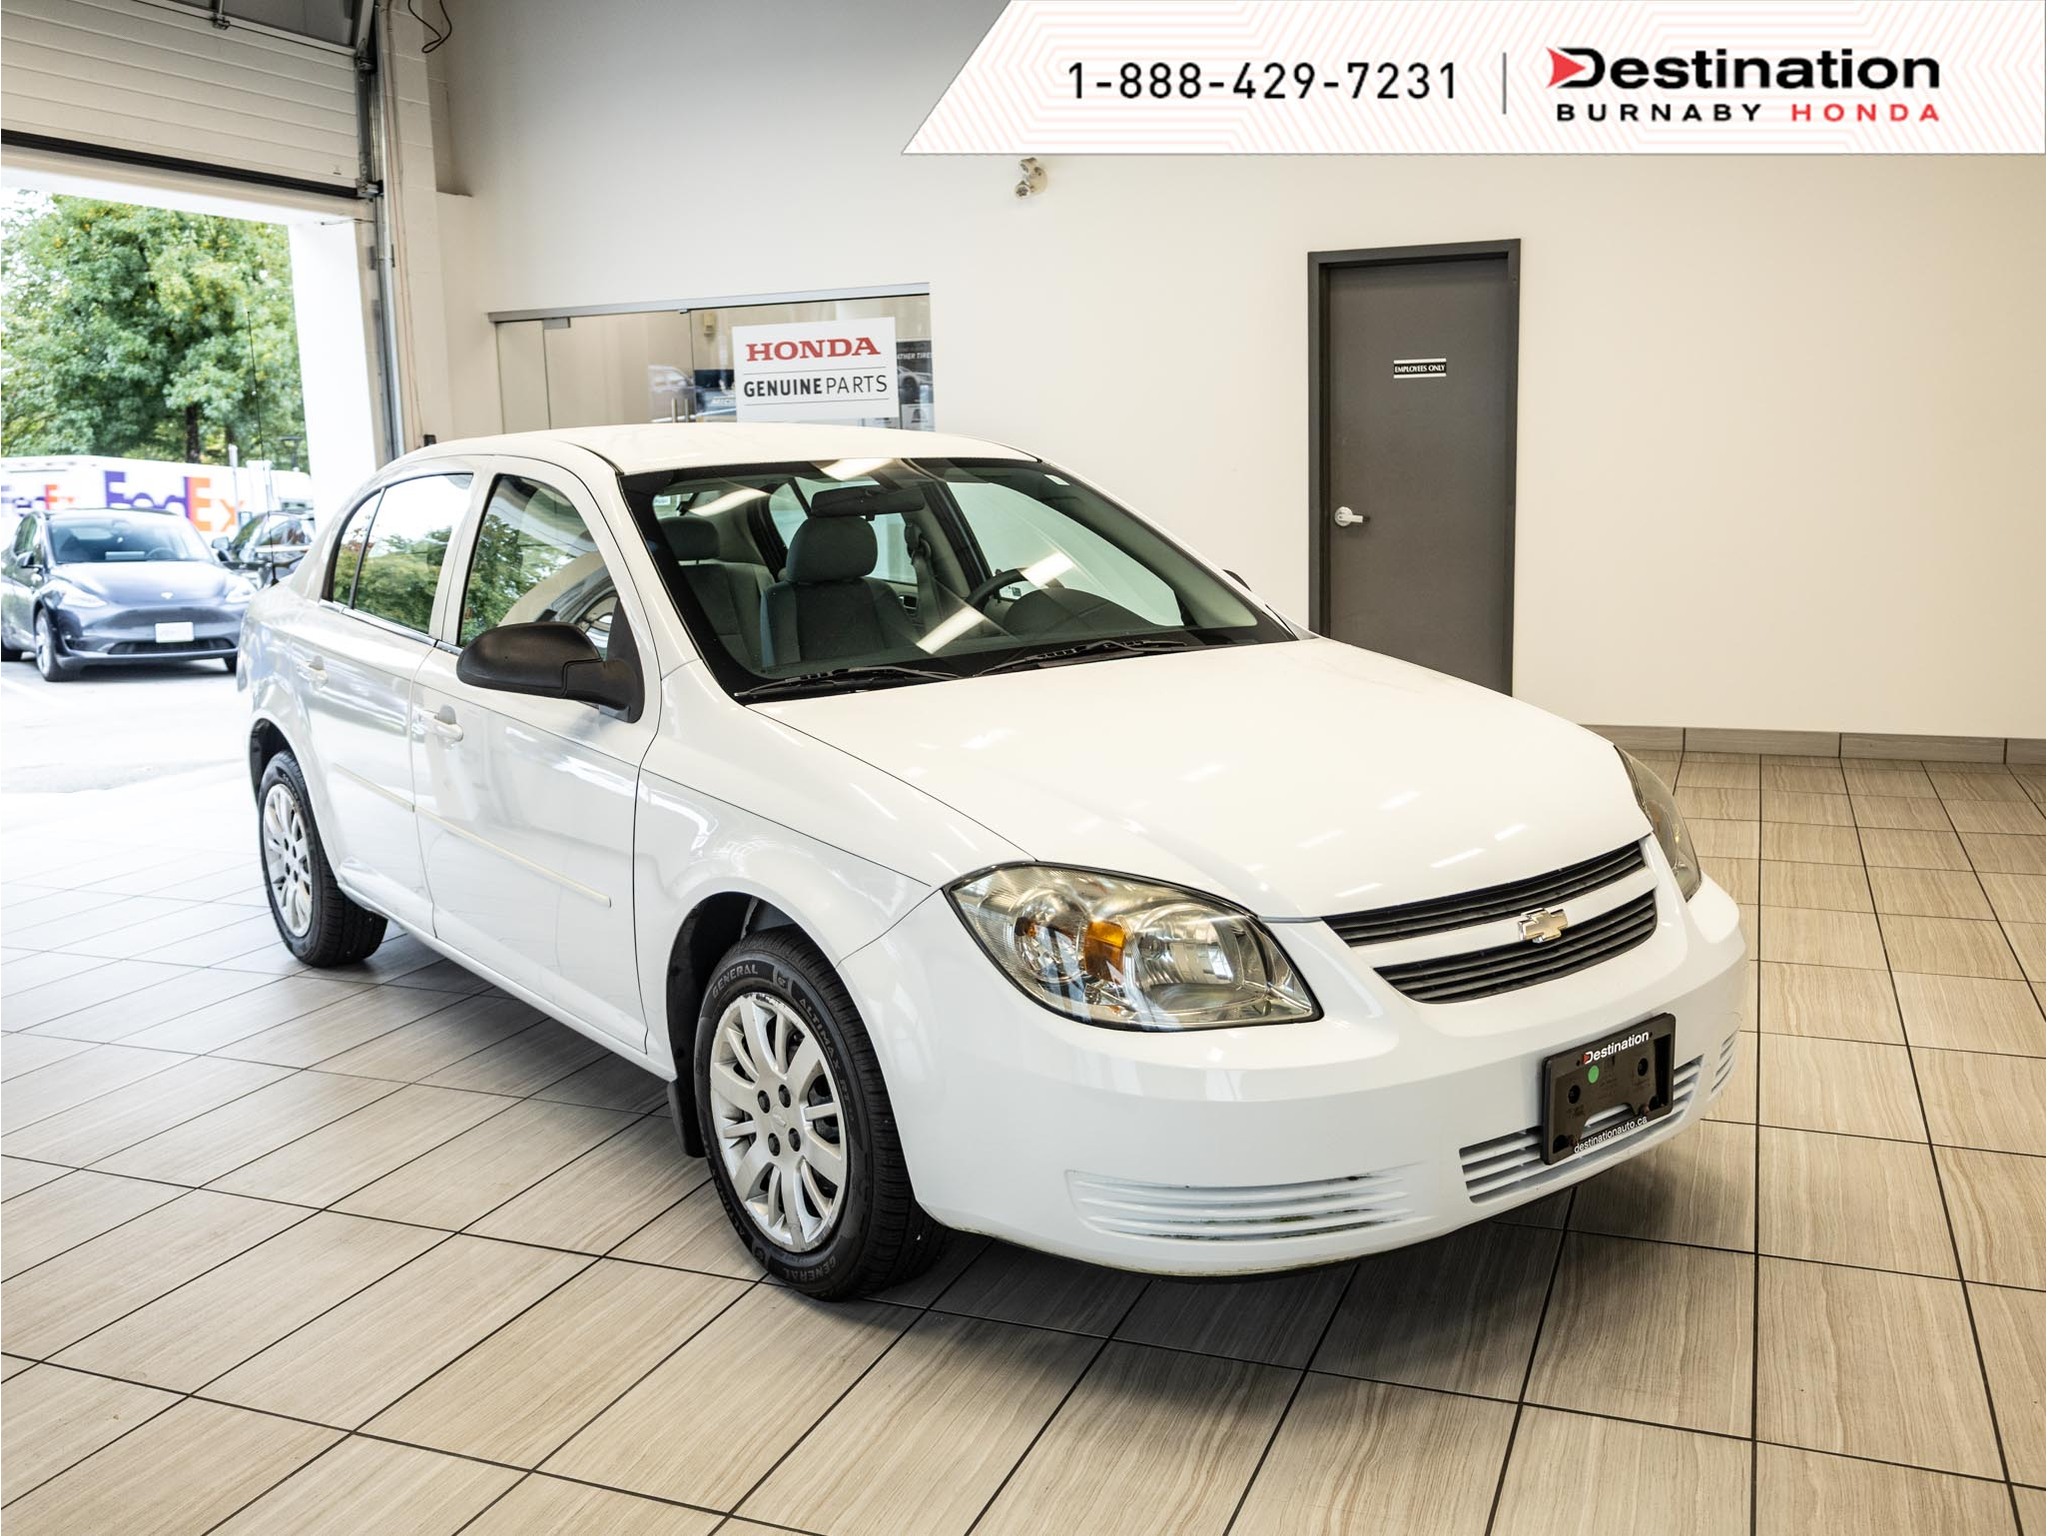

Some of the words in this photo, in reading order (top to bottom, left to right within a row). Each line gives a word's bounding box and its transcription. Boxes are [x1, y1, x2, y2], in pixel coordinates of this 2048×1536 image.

[745, 336, 881, 362] HONDA
[1394, 365, 1428, 373] EMPLOYEES
[1428, 364, 1446, 372] ONLY
[743, 377, 823, 398] GENUINE
[826, 374, 888, 395] PARTS
[712, 963, 759, 999] GENERAL
[799, 998, 842, 1069] ALTIMAX
[1583, 1031, 1649, 1065] Destination
[1573, 1115, 1649, 1154] destinationauto.ca
